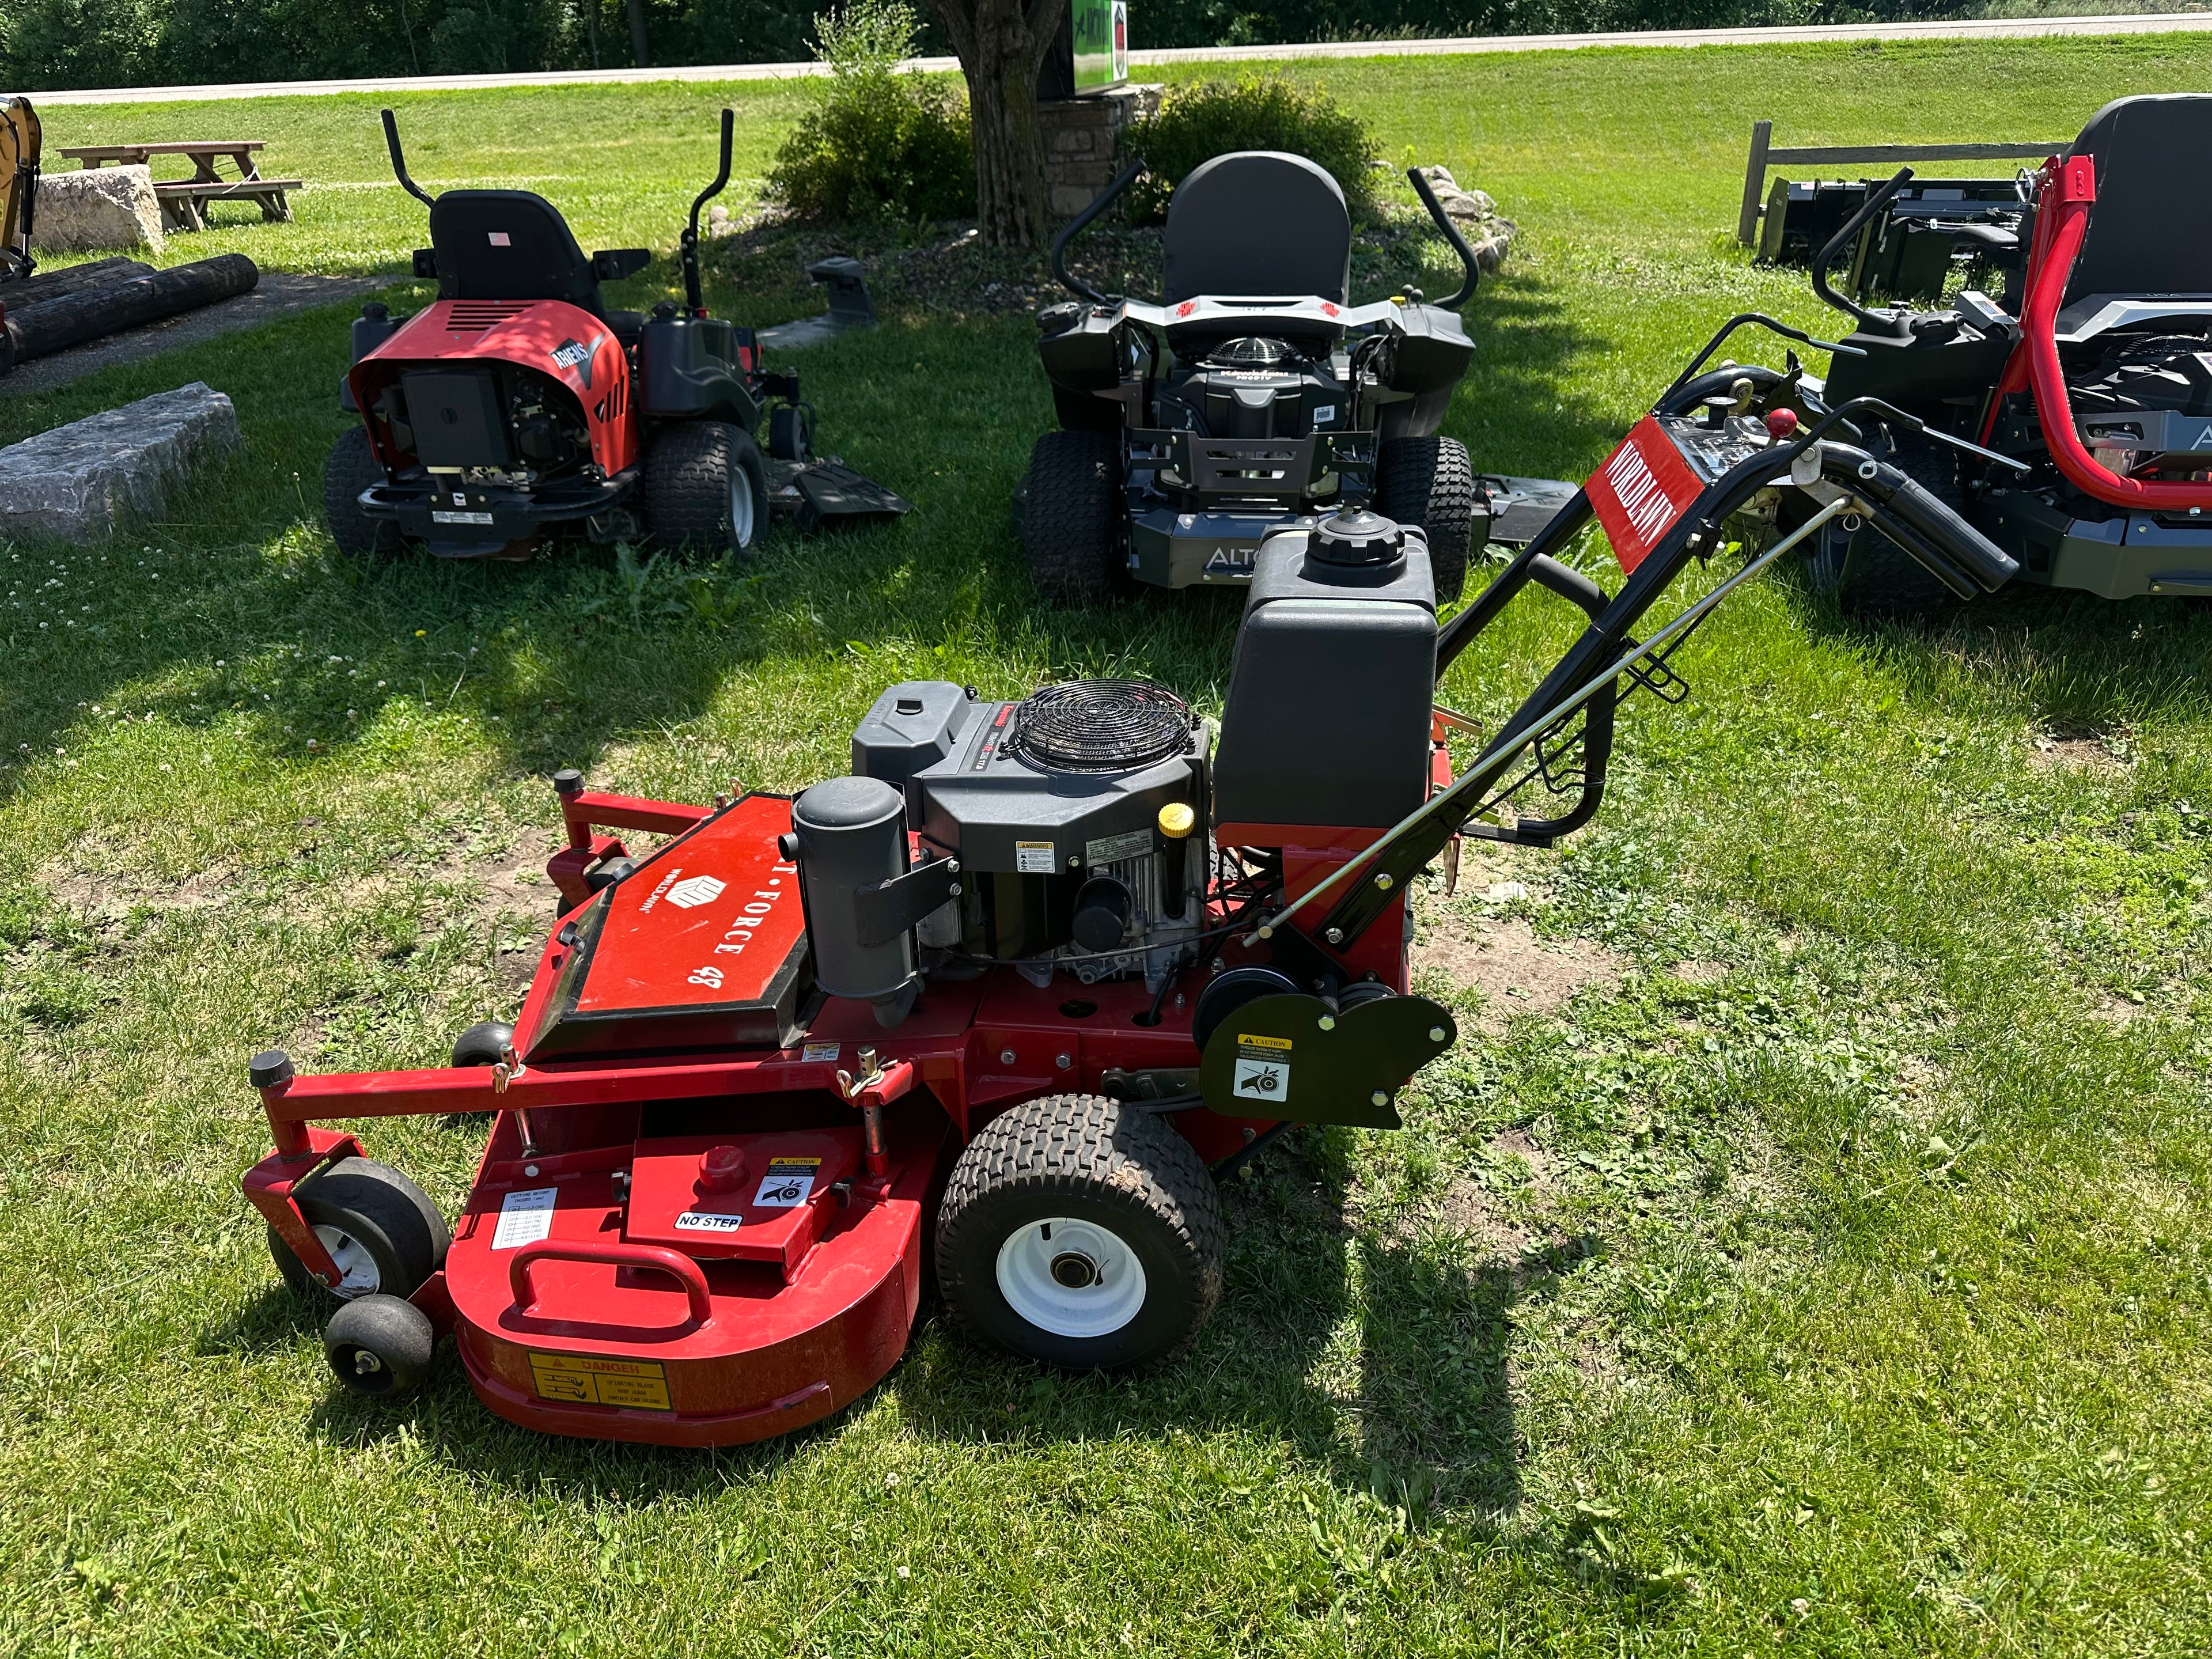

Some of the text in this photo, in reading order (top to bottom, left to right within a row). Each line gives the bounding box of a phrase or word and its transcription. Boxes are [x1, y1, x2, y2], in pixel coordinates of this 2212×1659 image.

[552, 342, 588, 370] ARIENS
[1604, 440, 1677, 547] WORLDLAWN
[714, 891, 781, 954] FORCE
[687, 966, 724, 989] 48
[1256, 1039, 1285, 1047] CAUTION
[679, 1216, 738, 1228] NO STEP
[581, 1361, 640, 1374] DANGER
